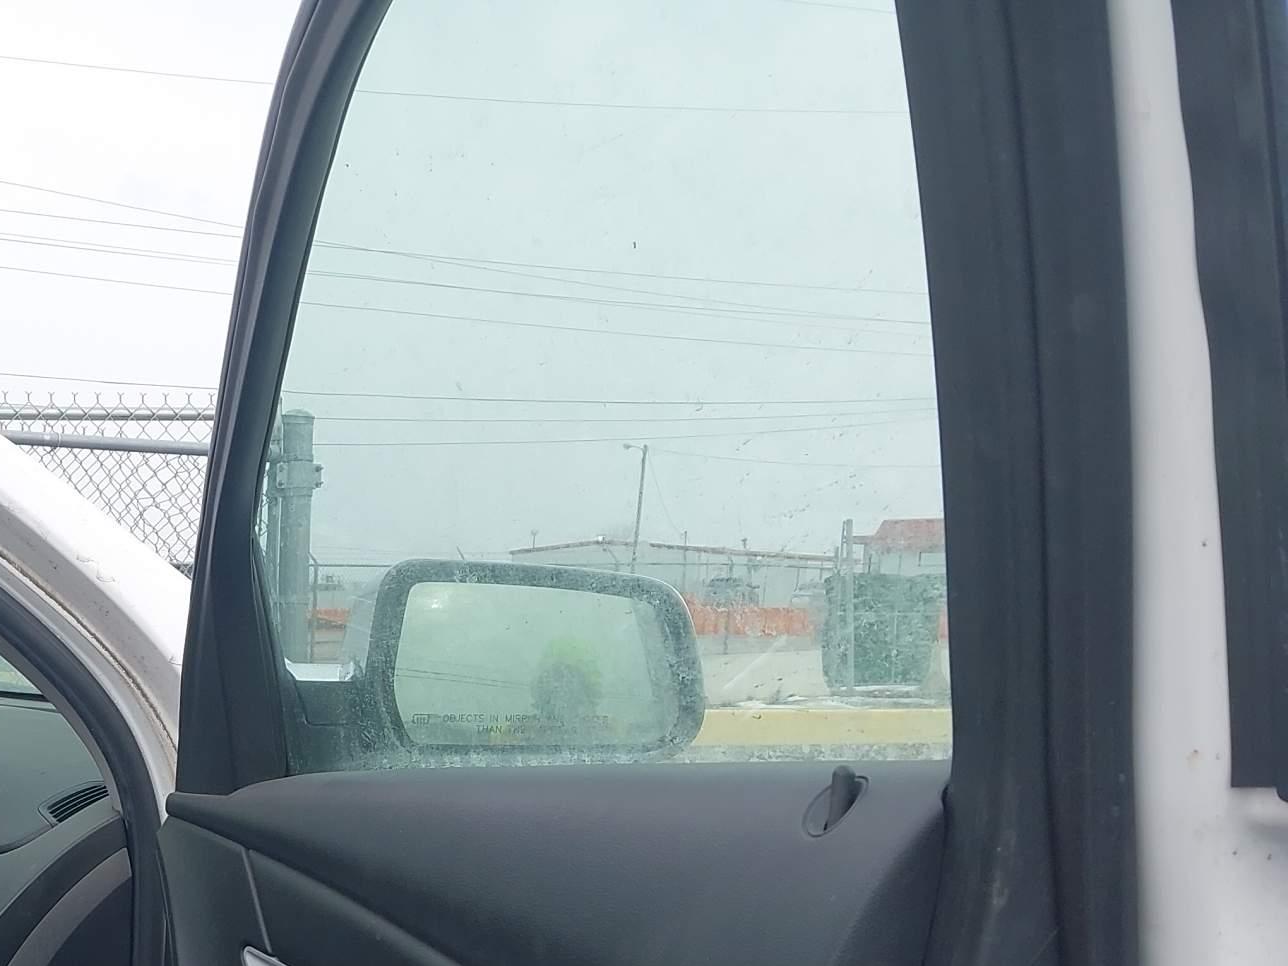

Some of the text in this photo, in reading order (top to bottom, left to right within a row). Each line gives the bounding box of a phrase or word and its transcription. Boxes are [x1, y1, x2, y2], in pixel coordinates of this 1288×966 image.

[442, 713, 486, 723] OBJECTS
[489, 713, 500, 723] IN
[476, 725, 503, 735] THAN
